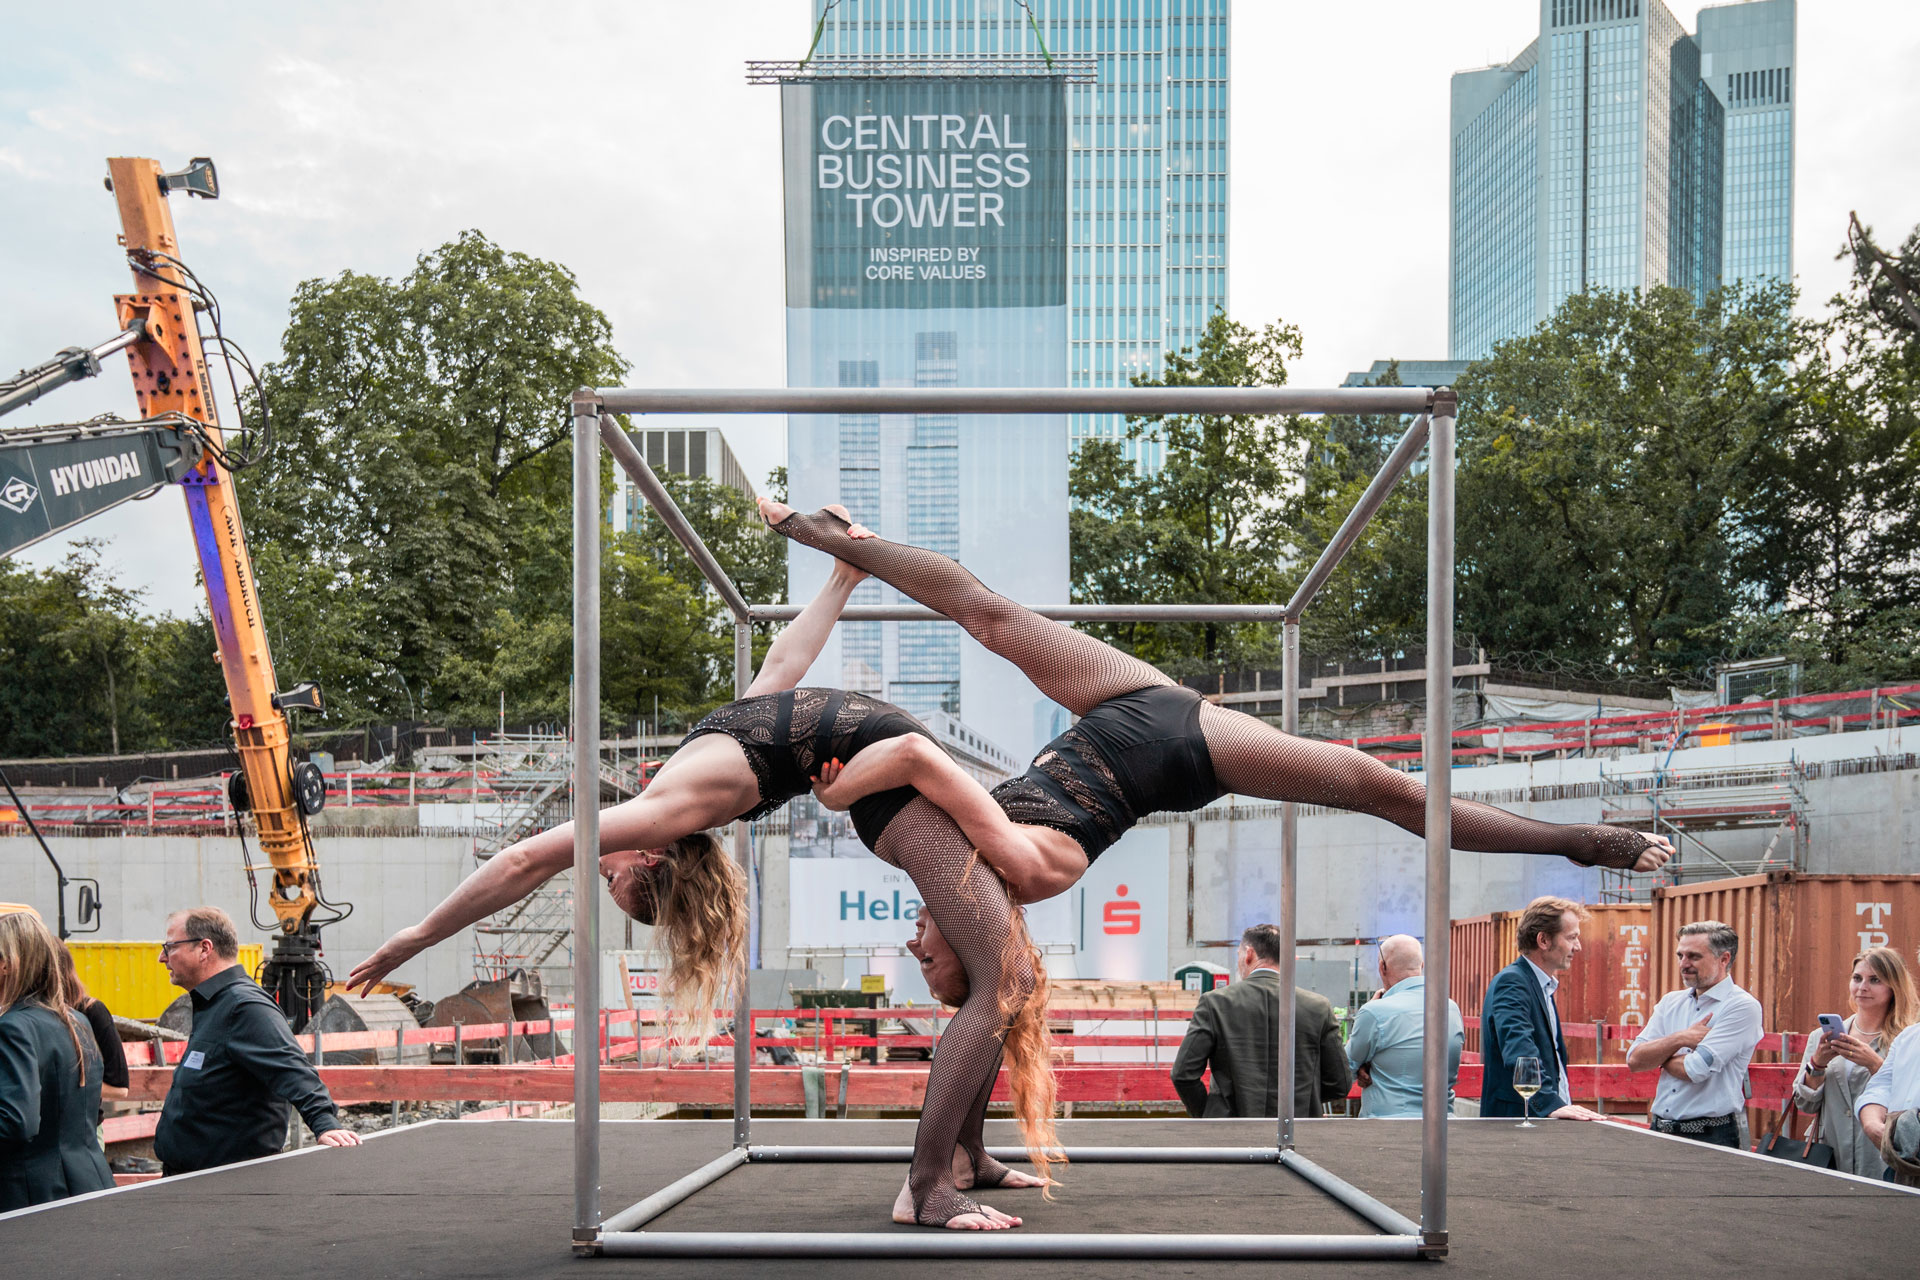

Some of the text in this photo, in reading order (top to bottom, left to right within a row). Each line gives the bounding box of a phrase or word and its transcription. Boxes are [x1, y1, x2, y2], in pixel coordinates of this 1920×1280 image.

[822, 113, 1027, 150] CENTRAL
[818, 153, 1031, 189] BUSINESS
[846, 192, 1005, 228] TOWER
[865, 265, 986, 280] CORE VALUES
[870, 248, 980, 262] INSPIRED BY
[50, 451, 141, 497] HYUNDAI
[225, 514, 256, 629] AWR ABBRUCH
[883, 874, 901, 883] EIN
